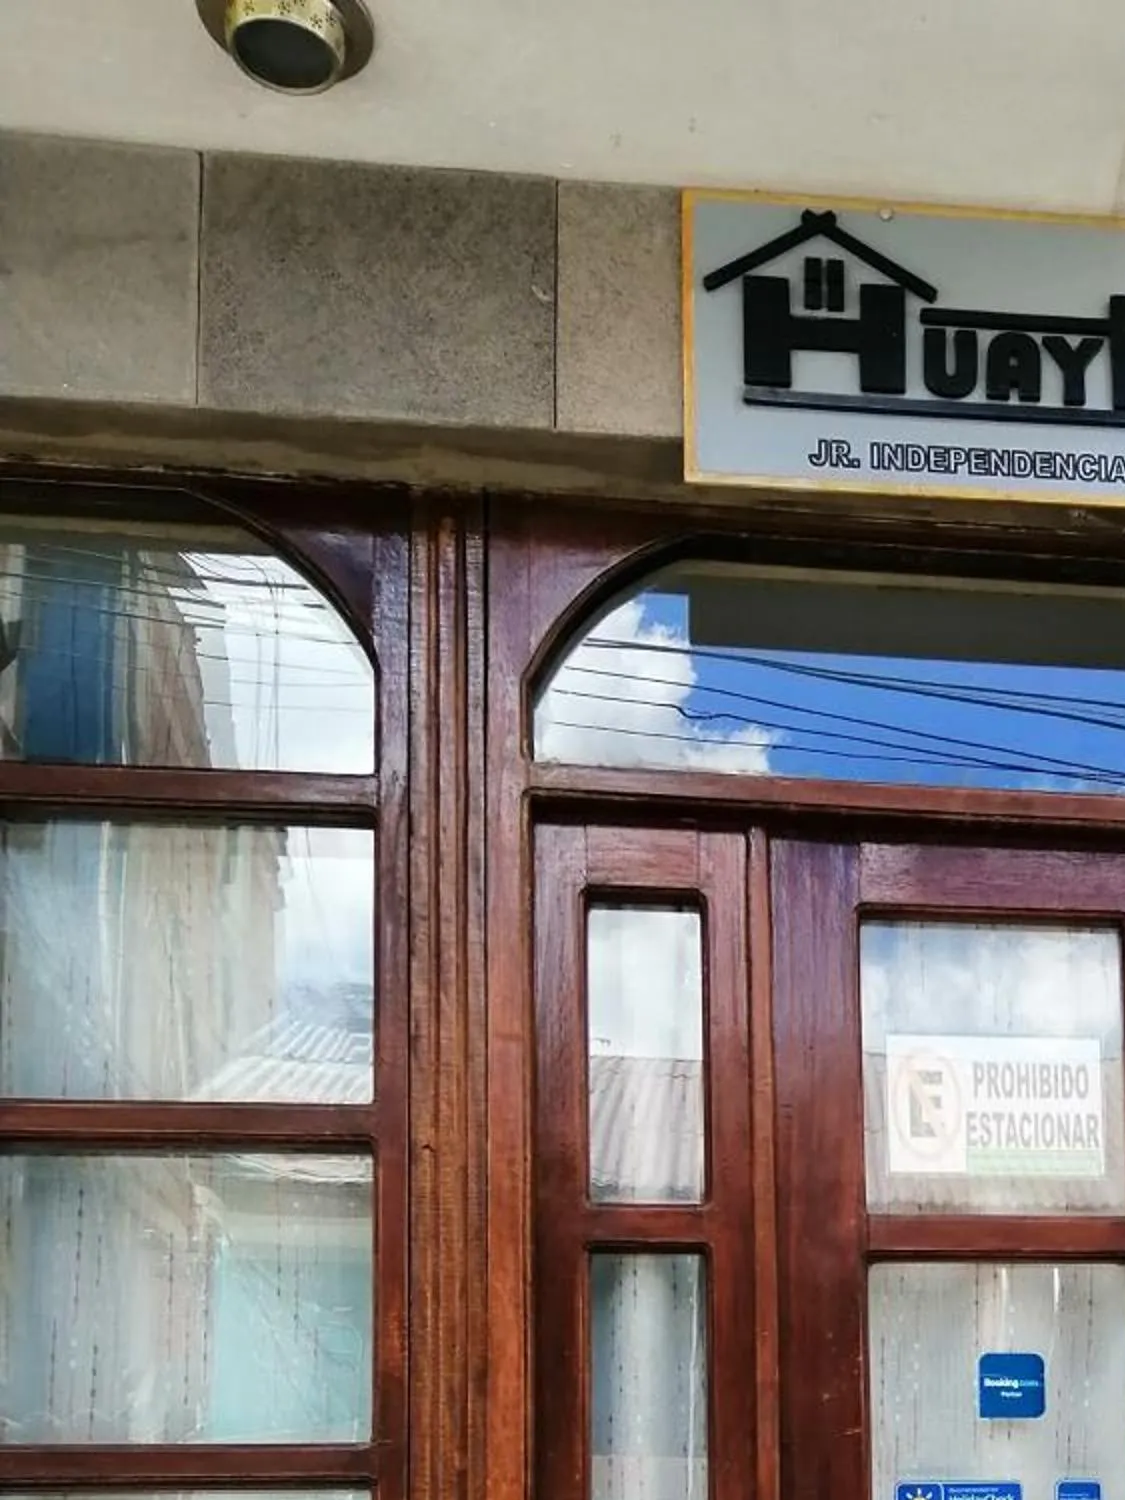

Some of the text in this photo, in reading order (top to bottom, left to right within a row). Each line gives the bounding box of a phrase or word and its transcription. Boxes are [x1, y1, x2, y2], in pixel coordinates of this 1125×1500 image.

[808, 439, 861, 469] JR.
[972, 1061, 1091, 1100] PROHIBIDO
[965, 1110, 1100, 1149] ESTACIONAR
